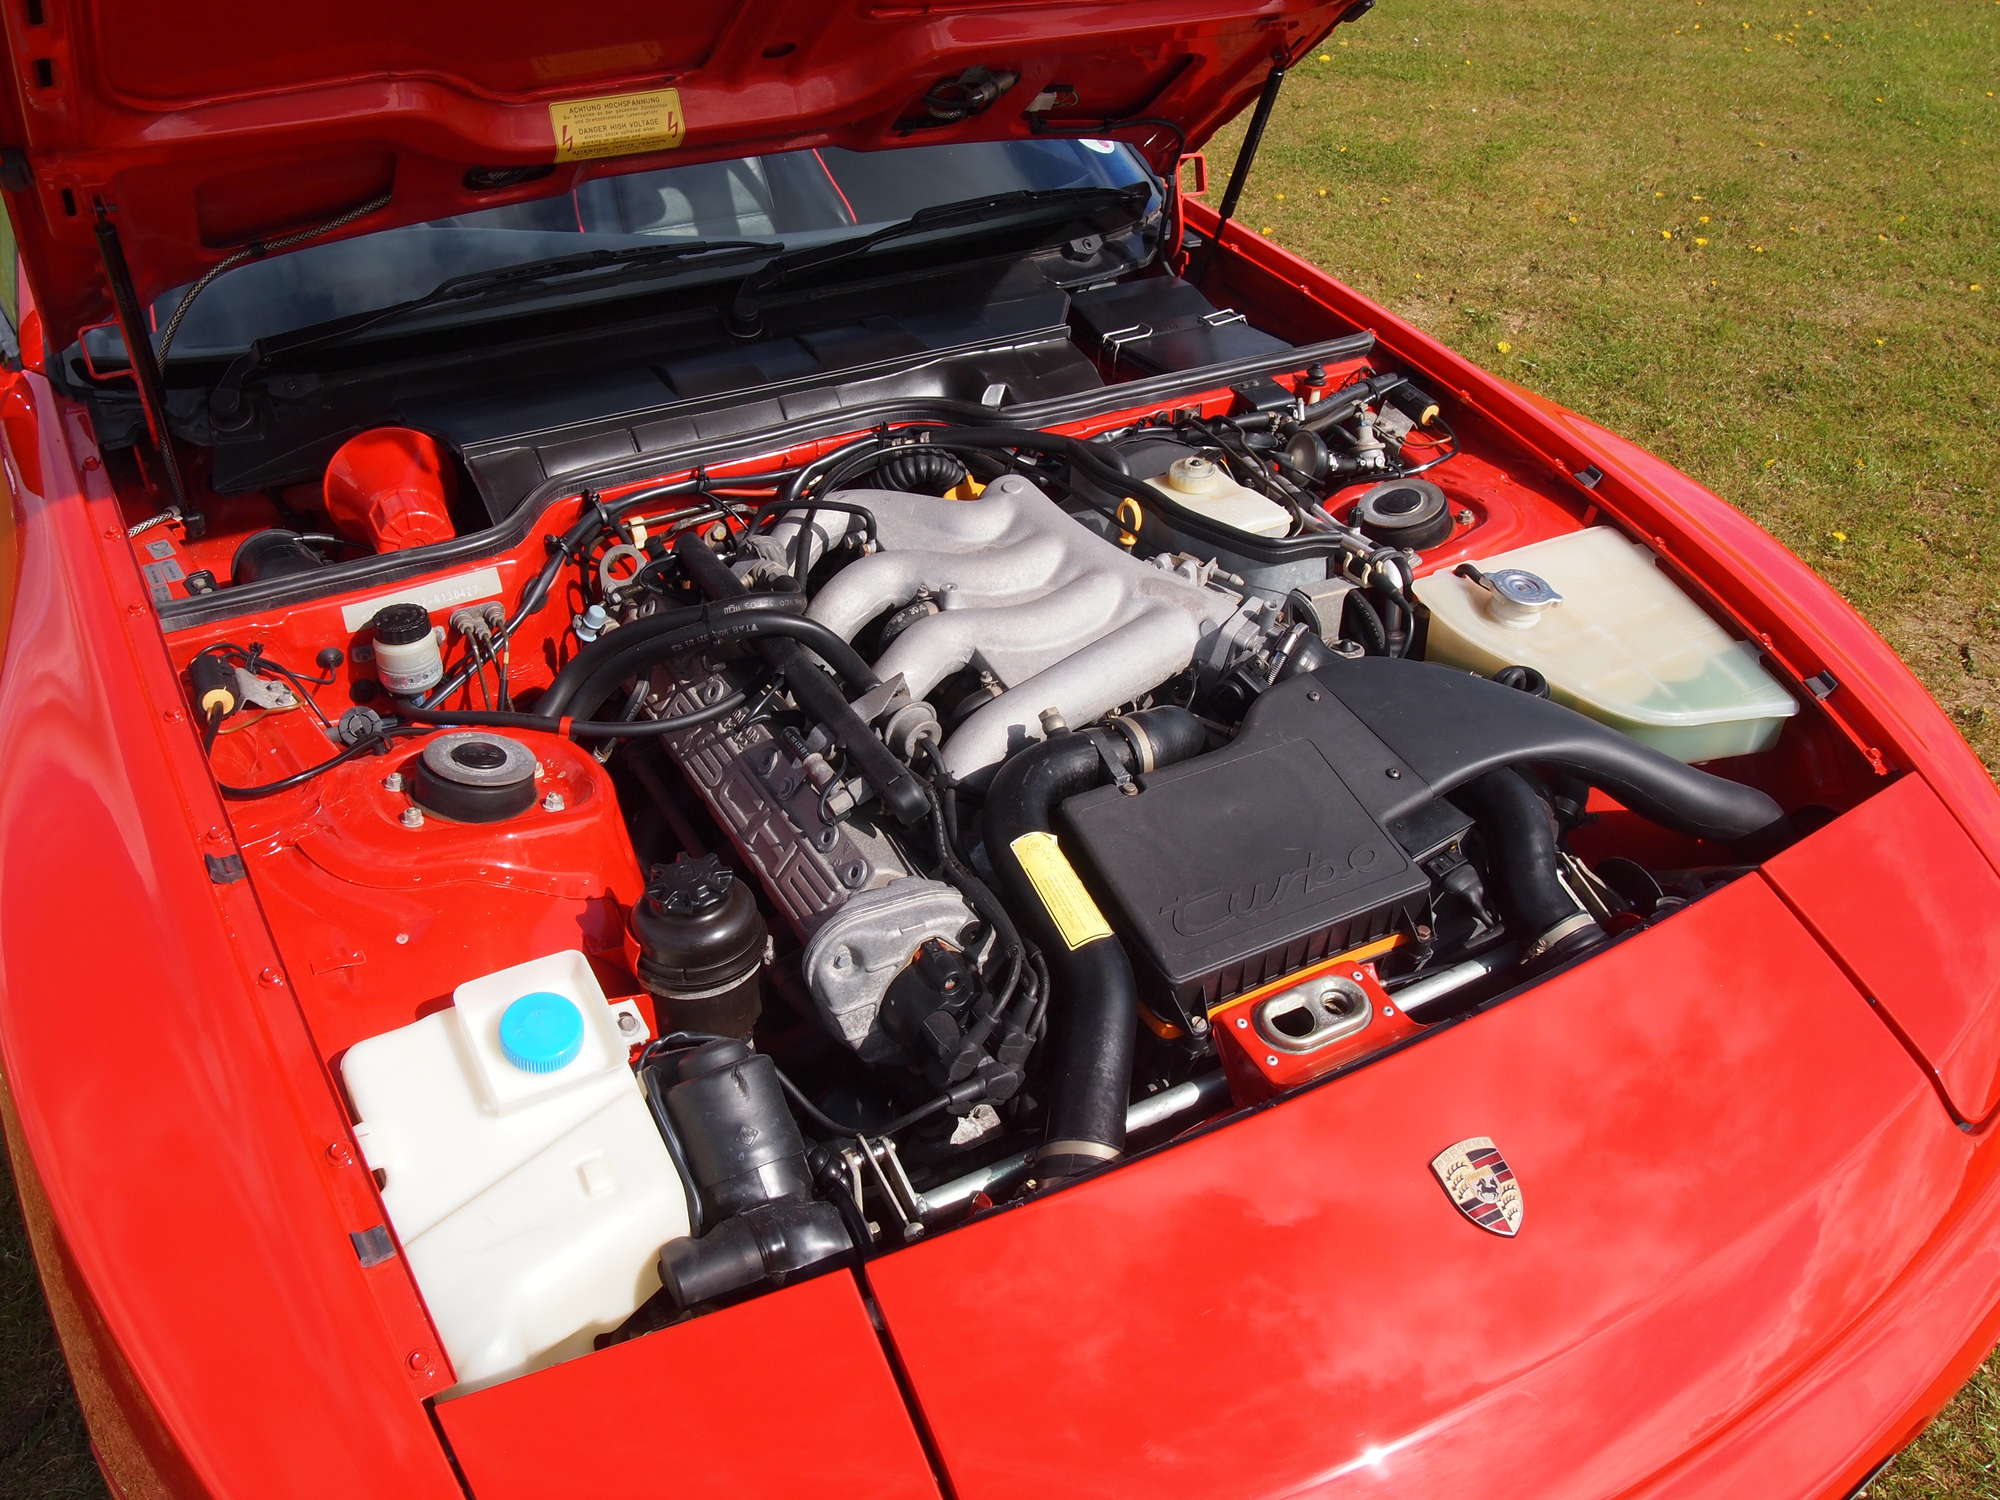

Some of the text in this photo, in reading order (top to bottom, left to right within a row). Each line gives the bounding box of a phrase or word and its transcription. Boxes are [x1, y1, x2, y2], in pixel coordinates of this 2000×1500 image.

[569, 103, 602, 115] ACHTUNG
[604, 96, 660, 109] HOCHSPANNUNG
[578, 125, 607, 136] DANGER
[610, 121, 627, 131] HIGH
[630, 117, 660, 128] VOLTAGE
